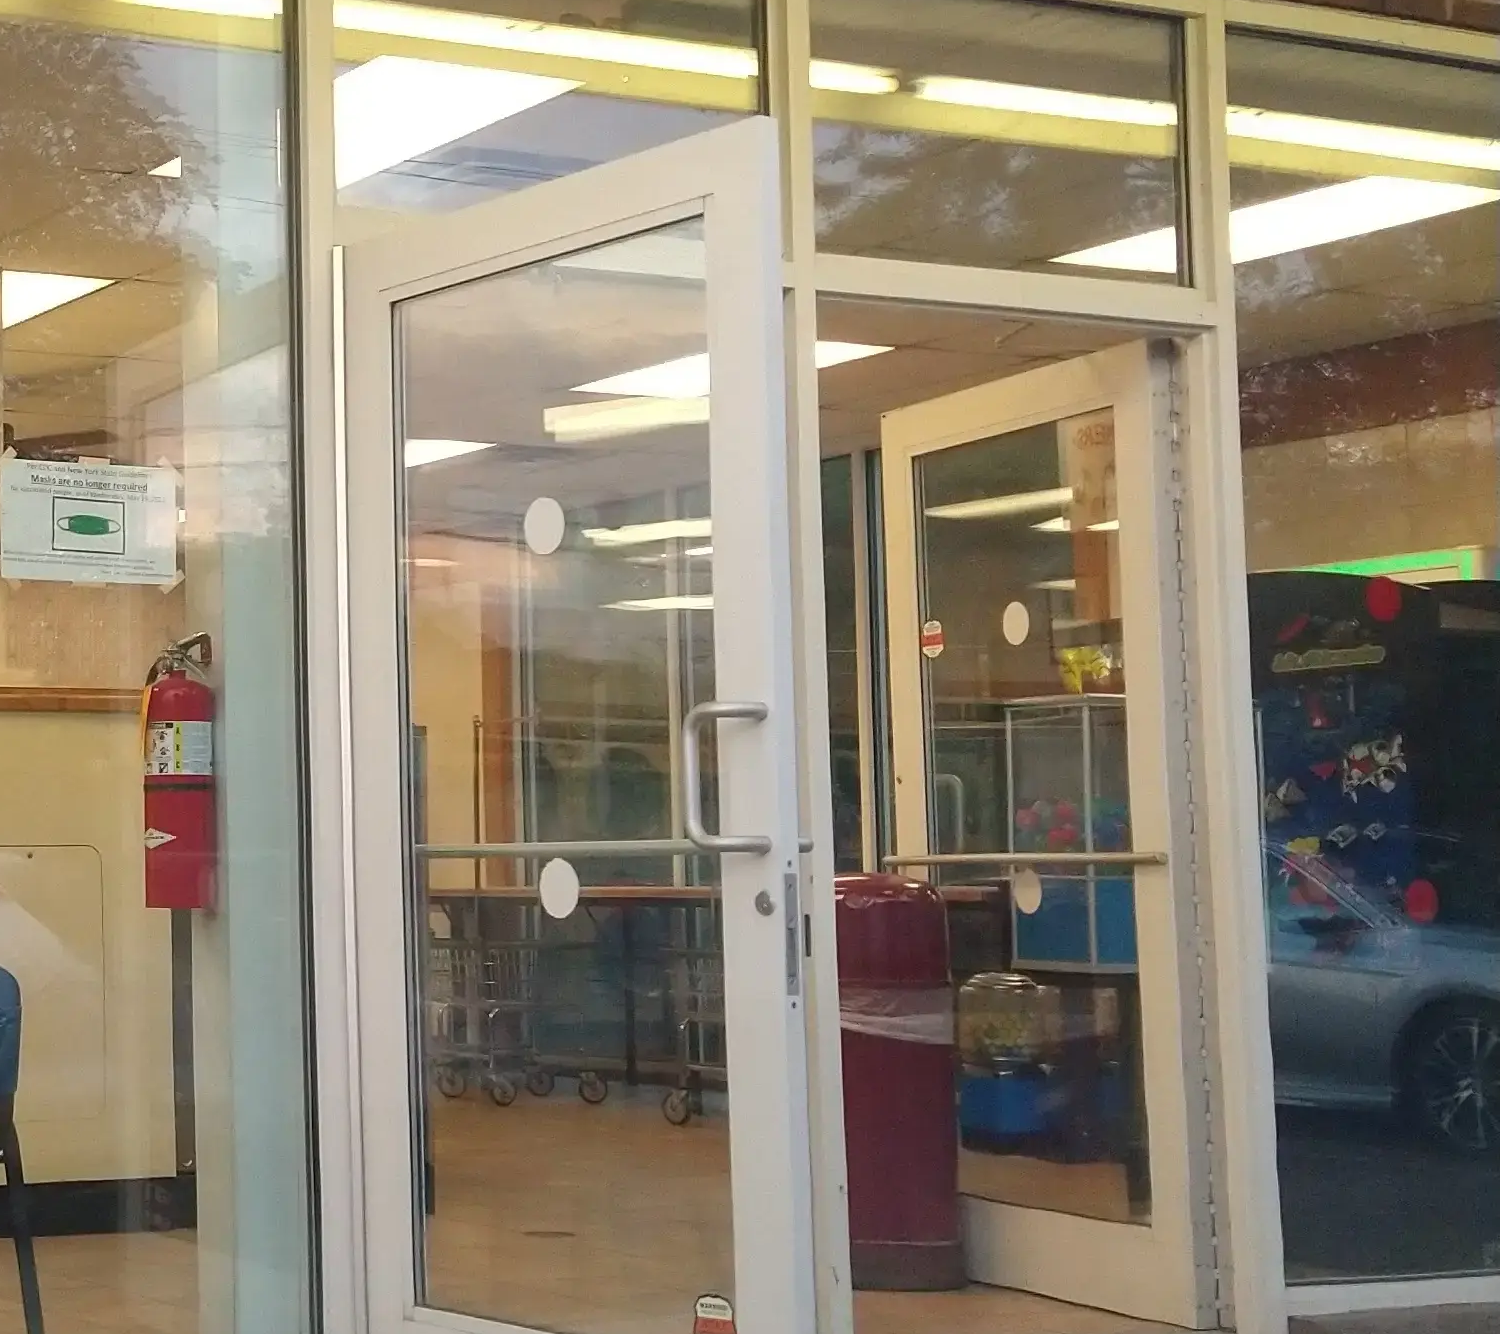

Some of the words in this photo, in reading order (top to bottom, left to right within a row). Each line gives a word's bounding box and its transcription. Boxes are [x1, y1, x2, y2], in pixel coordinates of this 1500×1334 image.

[58, 477, 71, 486] are
[73, 478, 84, 487] no
[85, 478, 111, 490] longer
[113, 482, 148, 493] required
